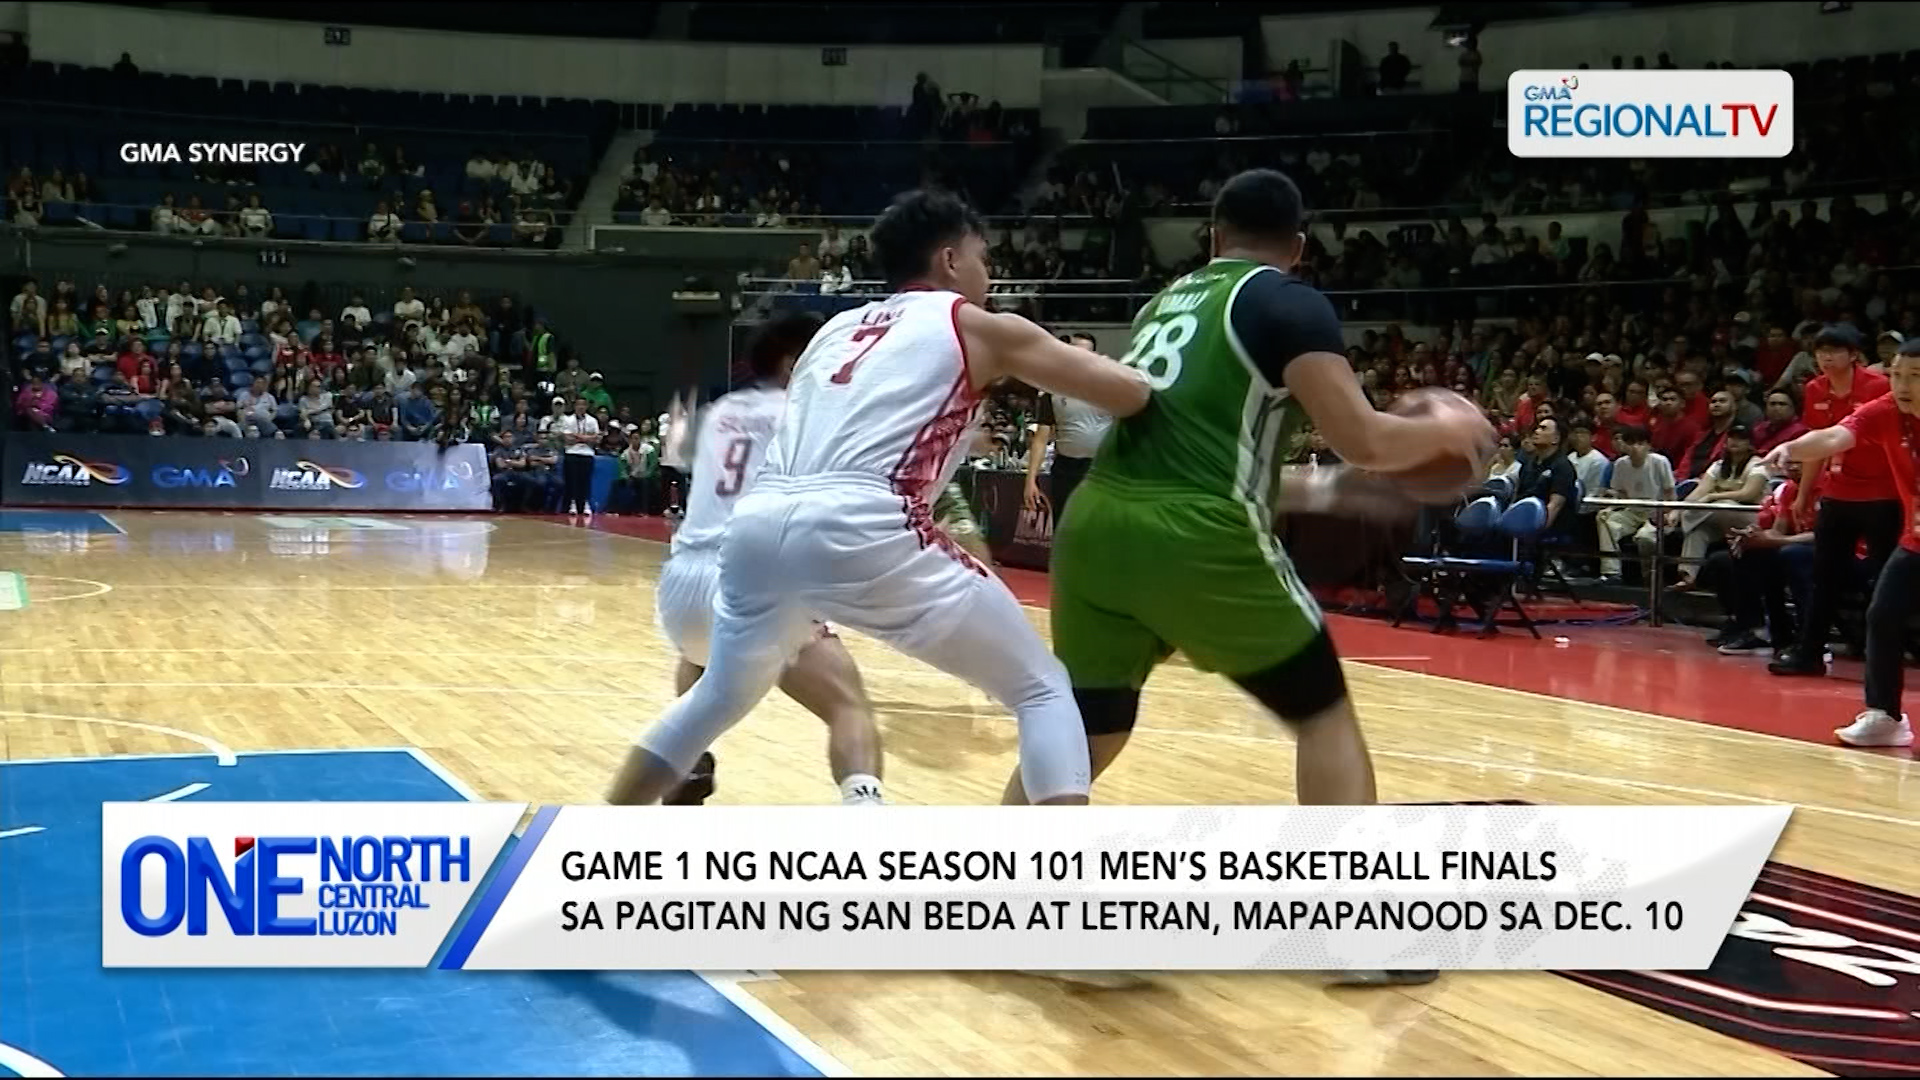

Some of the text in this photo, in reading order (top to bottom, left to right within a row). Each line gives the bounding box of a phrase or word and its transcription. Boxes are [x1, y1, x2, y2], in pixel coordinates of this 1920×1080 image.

[829, 325, 892, 385] 7
[21, 463, 91, 486] NCAA
[152, 465, 236, 488] GMA
[270, 467, 331, 490] NCAA
[715, 437, 753, 497] 9
